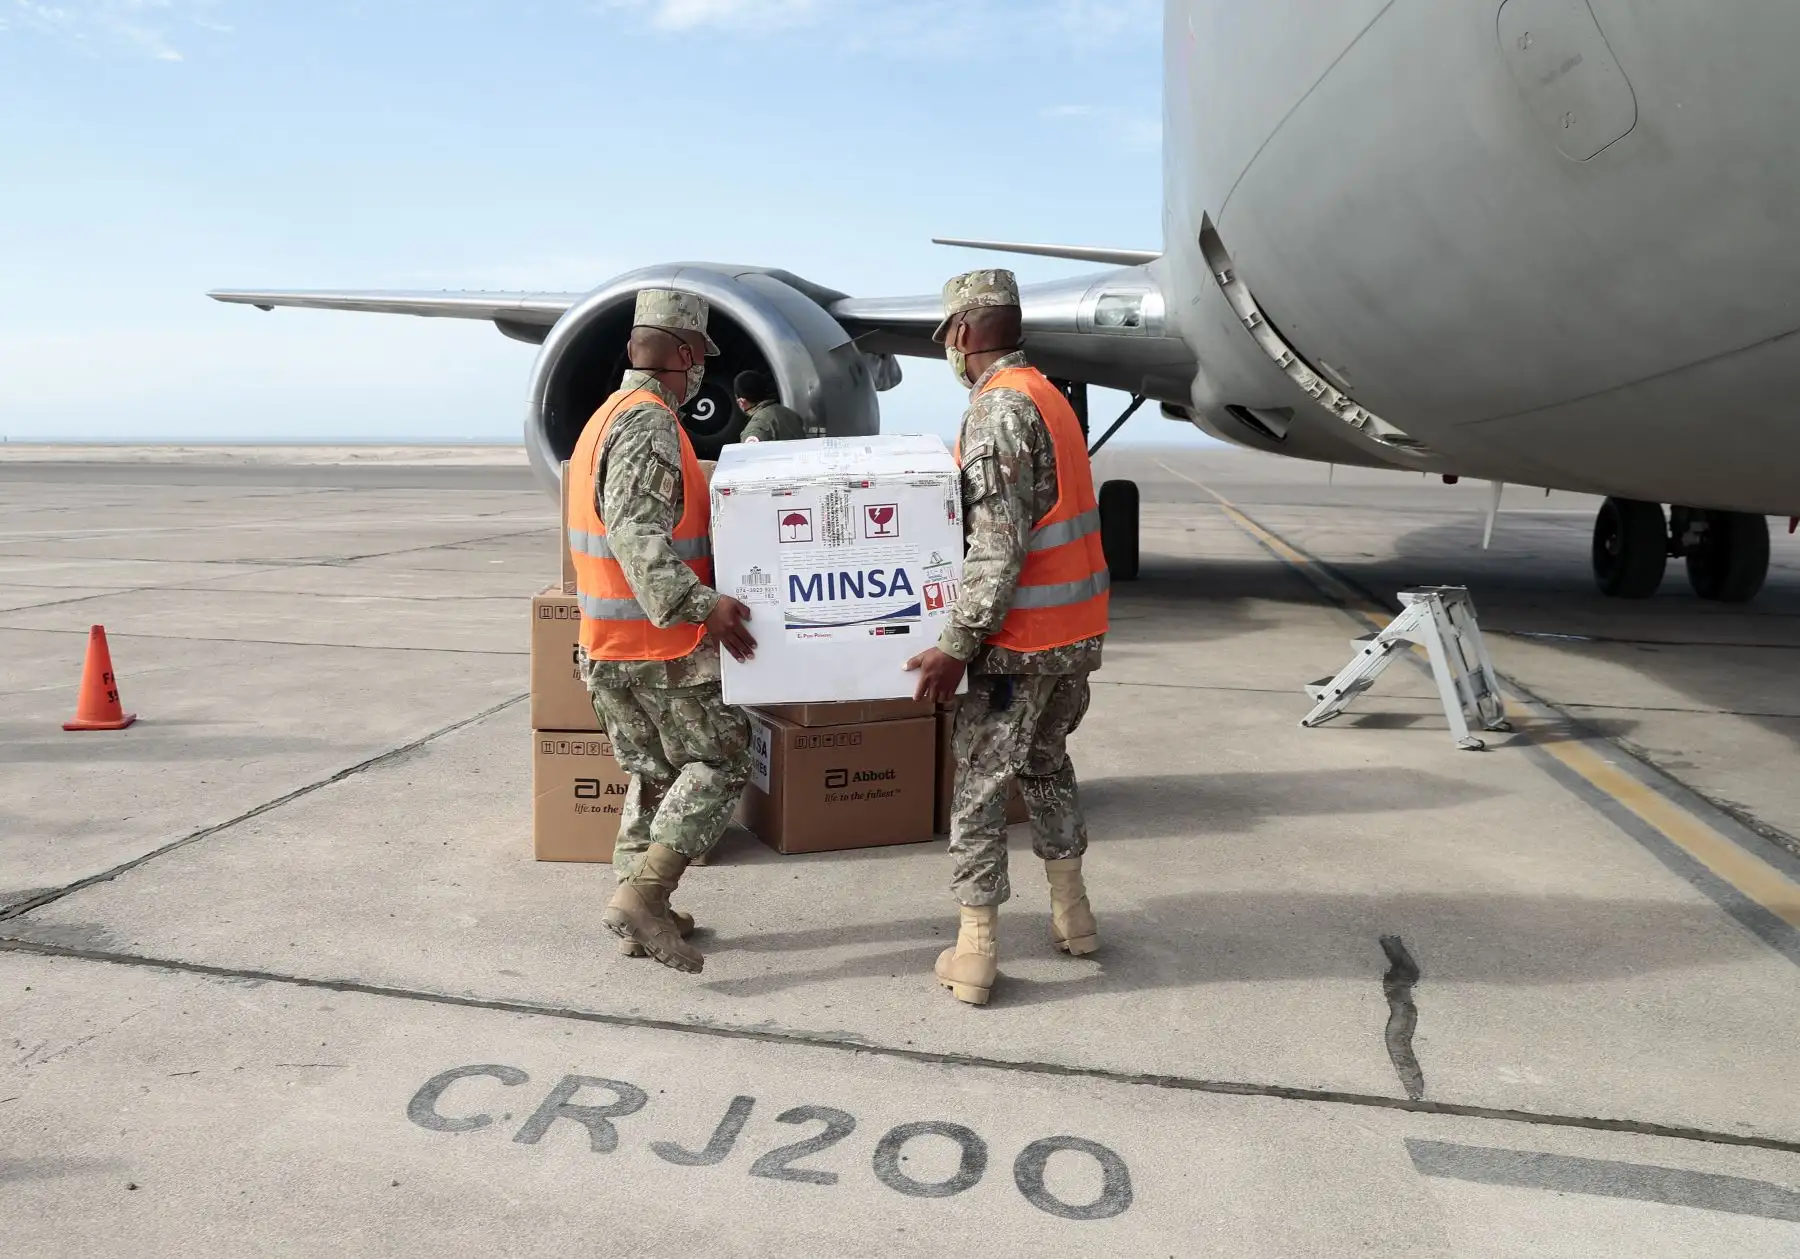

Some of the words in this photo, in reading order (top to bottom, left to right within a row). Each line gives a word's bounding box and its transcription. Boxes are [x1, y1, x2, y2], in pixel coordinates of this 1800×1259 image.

[788, 567, 914, 603] MINSA
[852, 768, 896, 782] Abbott
[850, 791, 865, 800] the
[574, 803, 589, 815] life
[591, 805, 601, 813] to
[603, 804, 618, 813] the
[405, 1063, 1134, 1220] CRJ200
